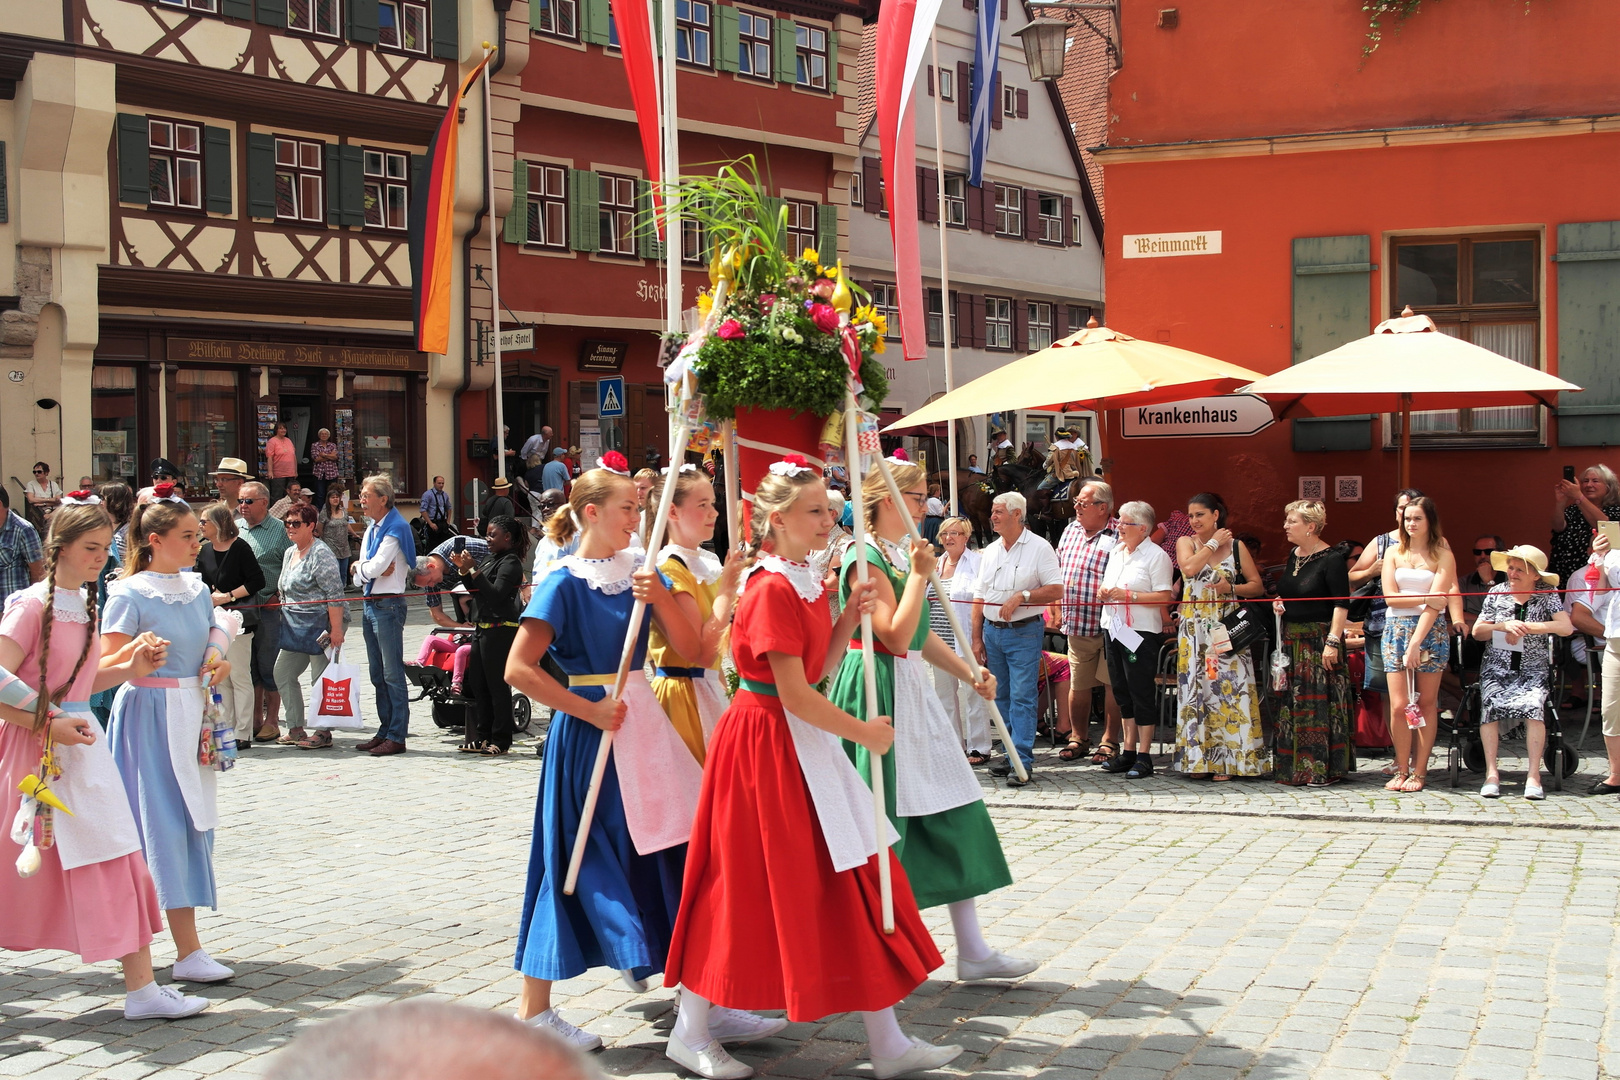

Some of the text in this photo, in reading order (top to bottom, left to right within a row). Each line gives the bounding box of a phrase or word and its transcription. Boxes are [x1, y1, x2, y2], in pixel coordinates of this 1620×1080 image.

[1134, 235, 1208, 254] Weinmarkt
[515, 333, 531, 346] Hotel
[188, 341, 232, 359] Wilhelm
[340, 349, 410, 369] Papierhandlung
[590, 353, 616, 364] beratung
[1138, 405, 1238, 425] Krankenhaus
